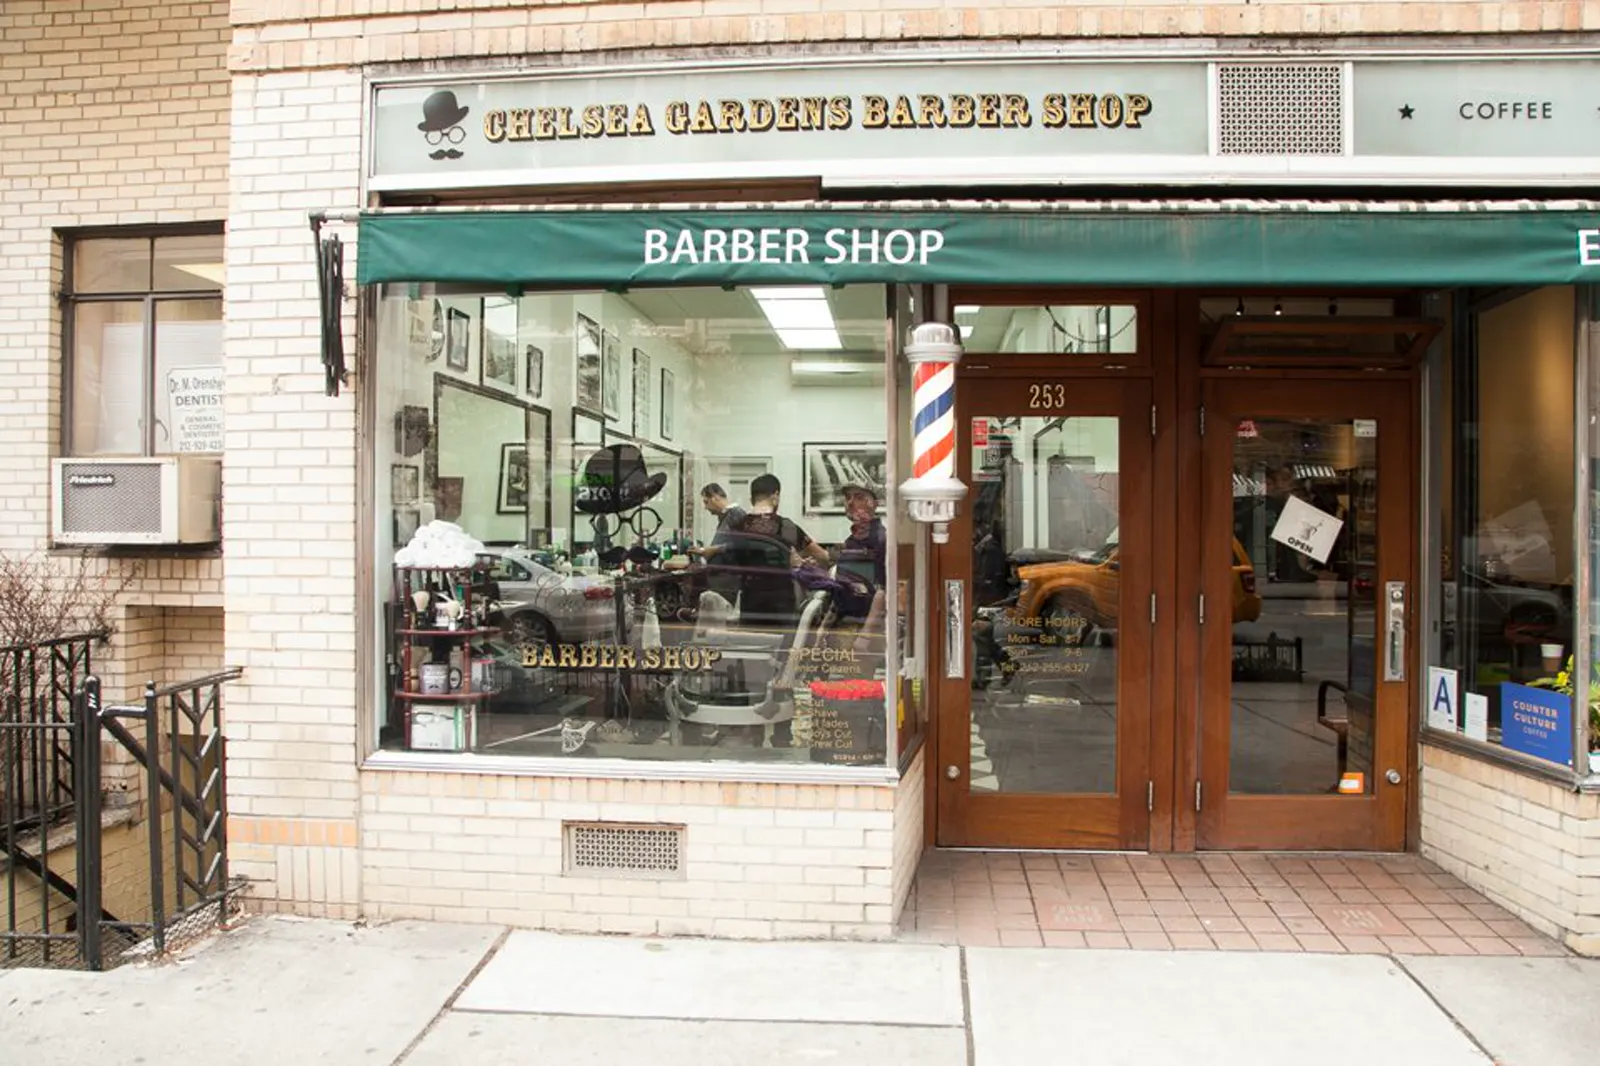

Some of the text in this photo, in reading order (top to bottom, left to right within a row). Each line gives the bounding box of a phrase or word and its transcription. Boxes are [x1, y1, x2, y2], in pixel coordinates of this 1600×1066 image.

[484, 92, 1152, 143] CHELSEA GARDENS BARBER SHOP
[1459, 102, 1552, 120] COFFEE
[644, 228, 944, 265] BARBER SHOP
[175, 394, 223, 406] DENTIST
[1029, 384, 1065, 409] 253
[1287, 536, 1314, 553] OPEN
[1002, 616, 1087, 627] STORE HOURS
[520, 643, 722, 671] BARBER SHOP
[1433, 676, 1452, 715] A
[1513, 700, 1559, 719] COUNTER
[1513, 712, 1557, 731] CULTURE
